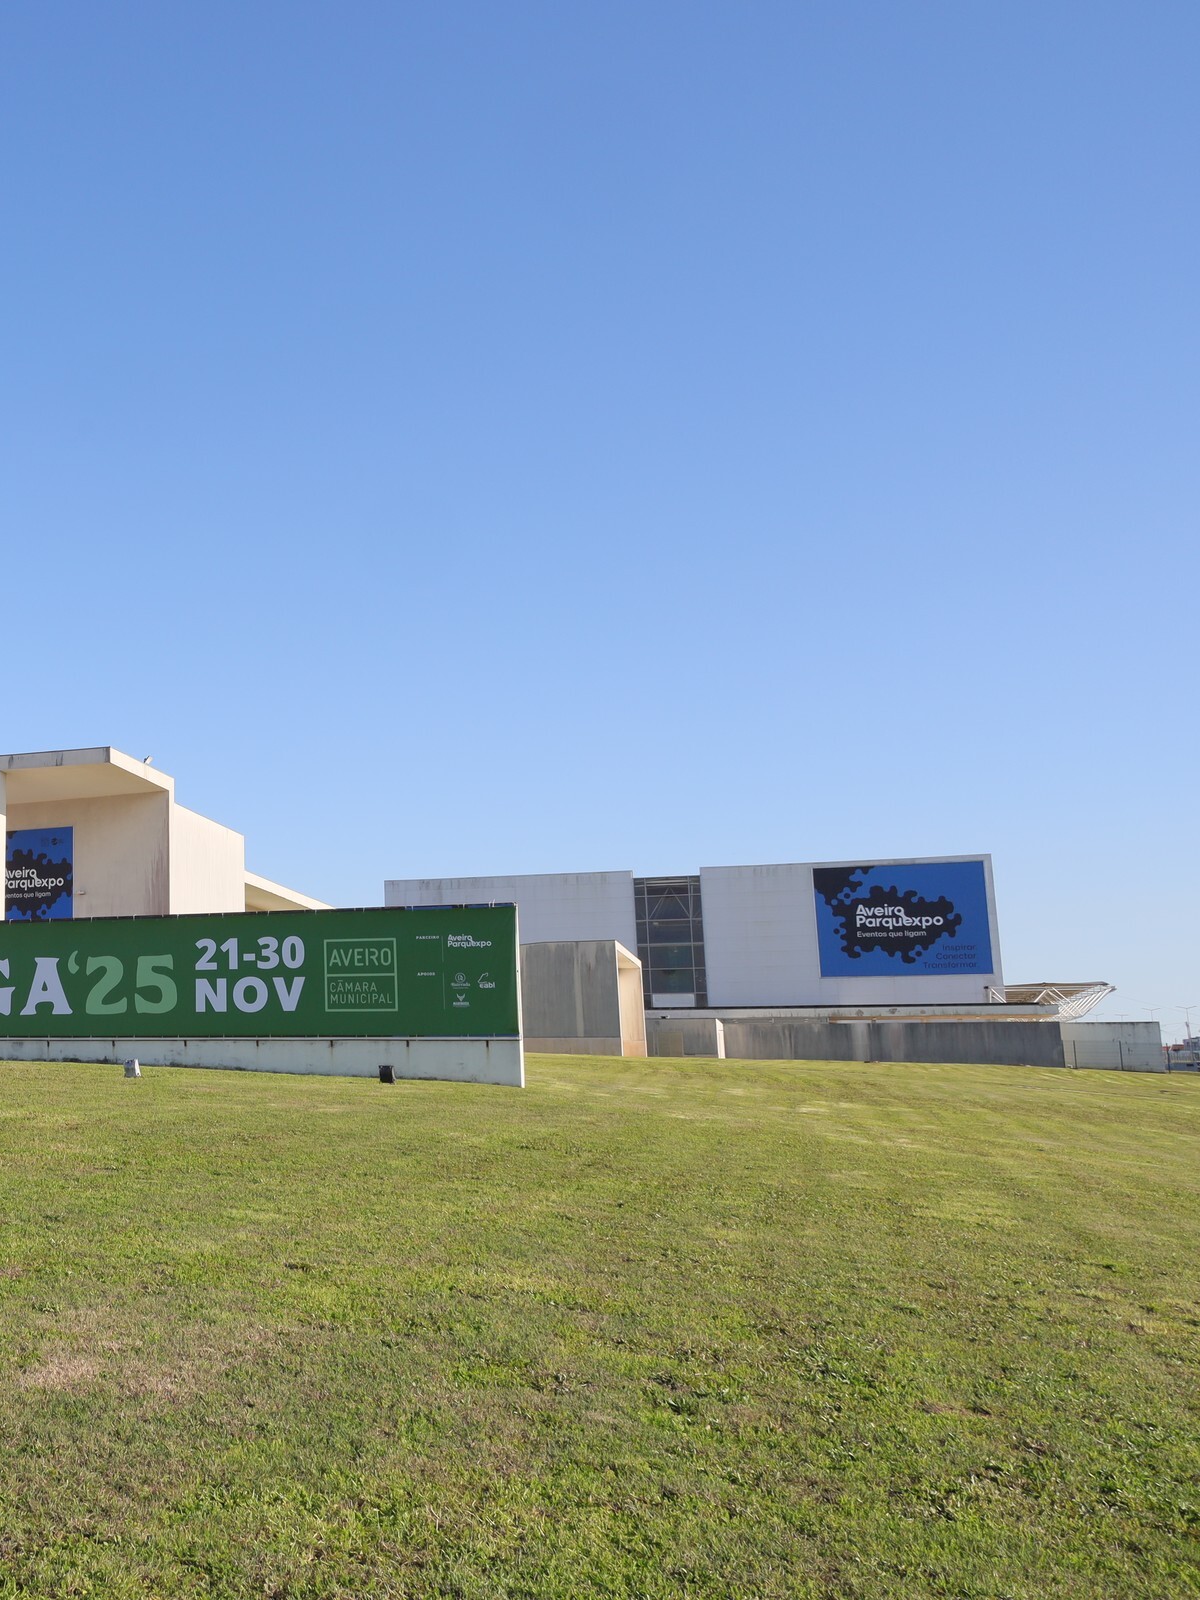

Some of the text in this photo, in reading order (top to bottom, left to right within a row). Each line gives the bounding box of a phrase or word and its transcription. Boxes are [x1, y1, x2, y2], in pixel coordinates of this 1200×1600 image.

[23, 891, 35, 899] que
[35, 890, 52, 898] ligam
[855, 904, 905, 917] Aveiro
[856, 915, 943, 929] Parquexpo
[447, 934, 473, 942] Aveiro
[856, 929, 927, 939] Eventos que ligam
[447, 940, 492, 948] Parquexpo
[195, 935, 306, 971] 21-30
[329, 947, 392, 967] AVEIRO
[195, 976, 306, 1013] NOV
[330, 992, 393, 1004] MUNICIPAL
